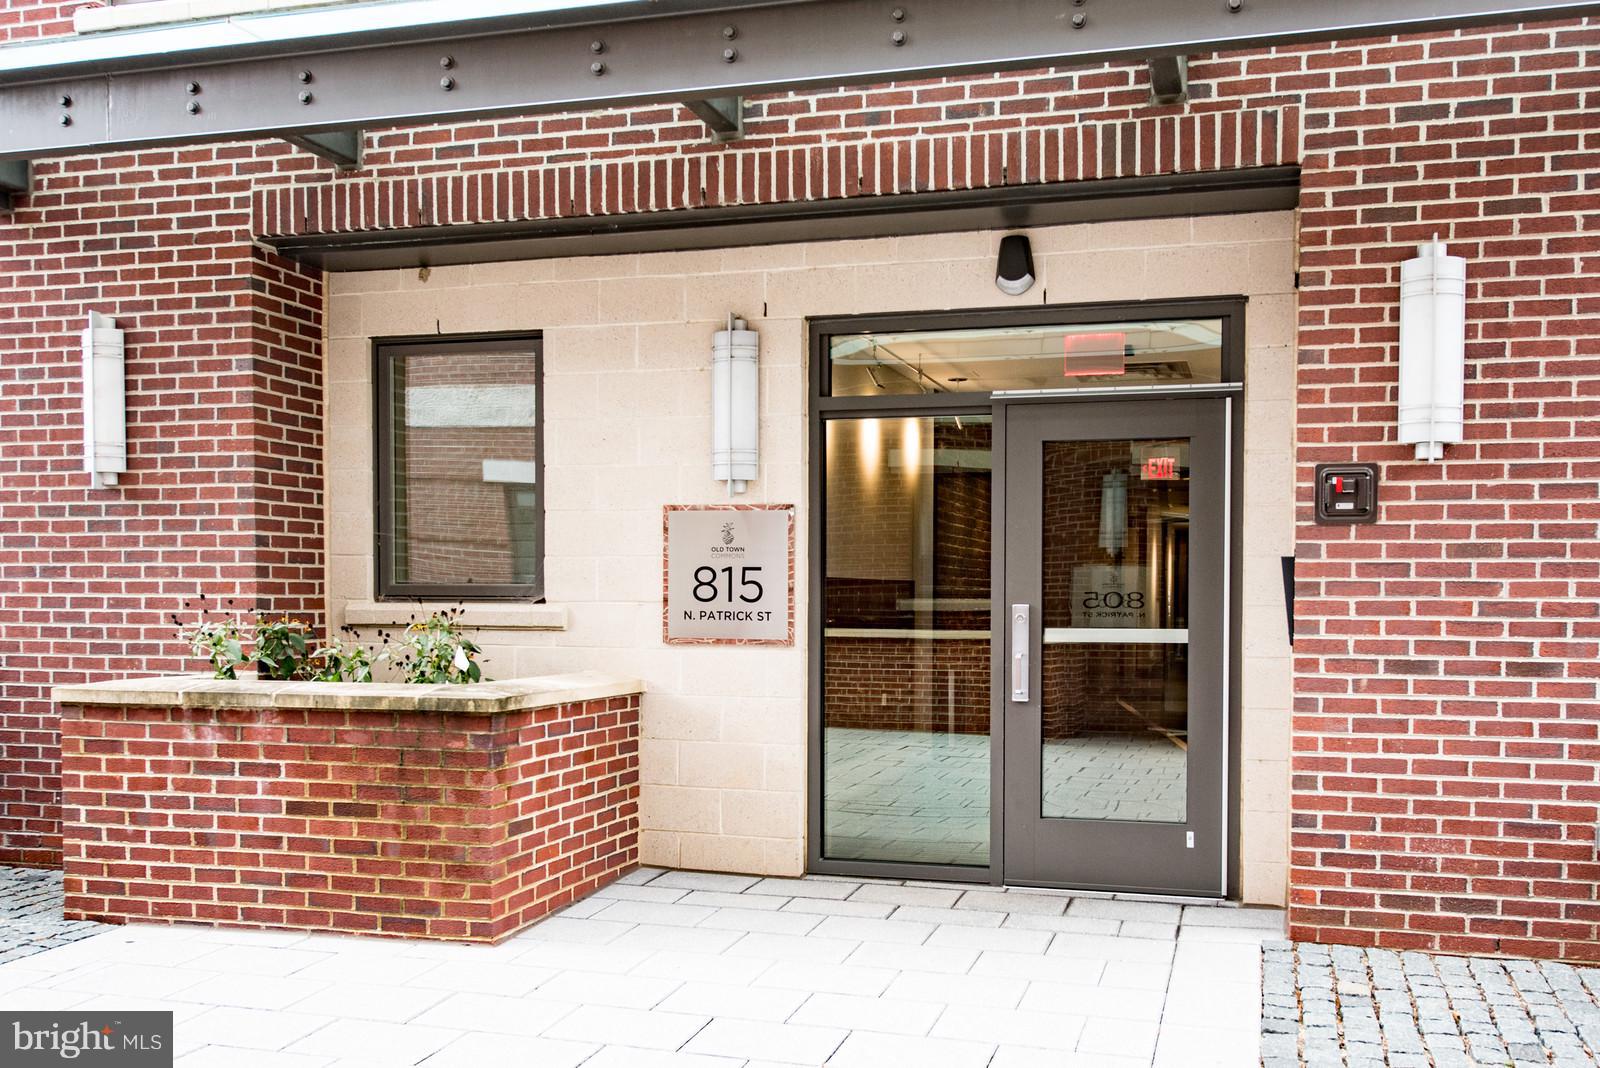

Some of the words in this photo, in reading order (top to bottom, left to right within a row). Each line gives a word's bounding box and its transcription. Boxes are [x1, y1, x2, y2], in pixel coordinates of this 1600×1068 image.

[1148, 457, 1176, 479] EXIT
[692, 566, 764, 603] 815
[683, 610, 696, 621] N.
[699, 610, 753, 622] PATRICK
[757, 611, 772, 622] ST
